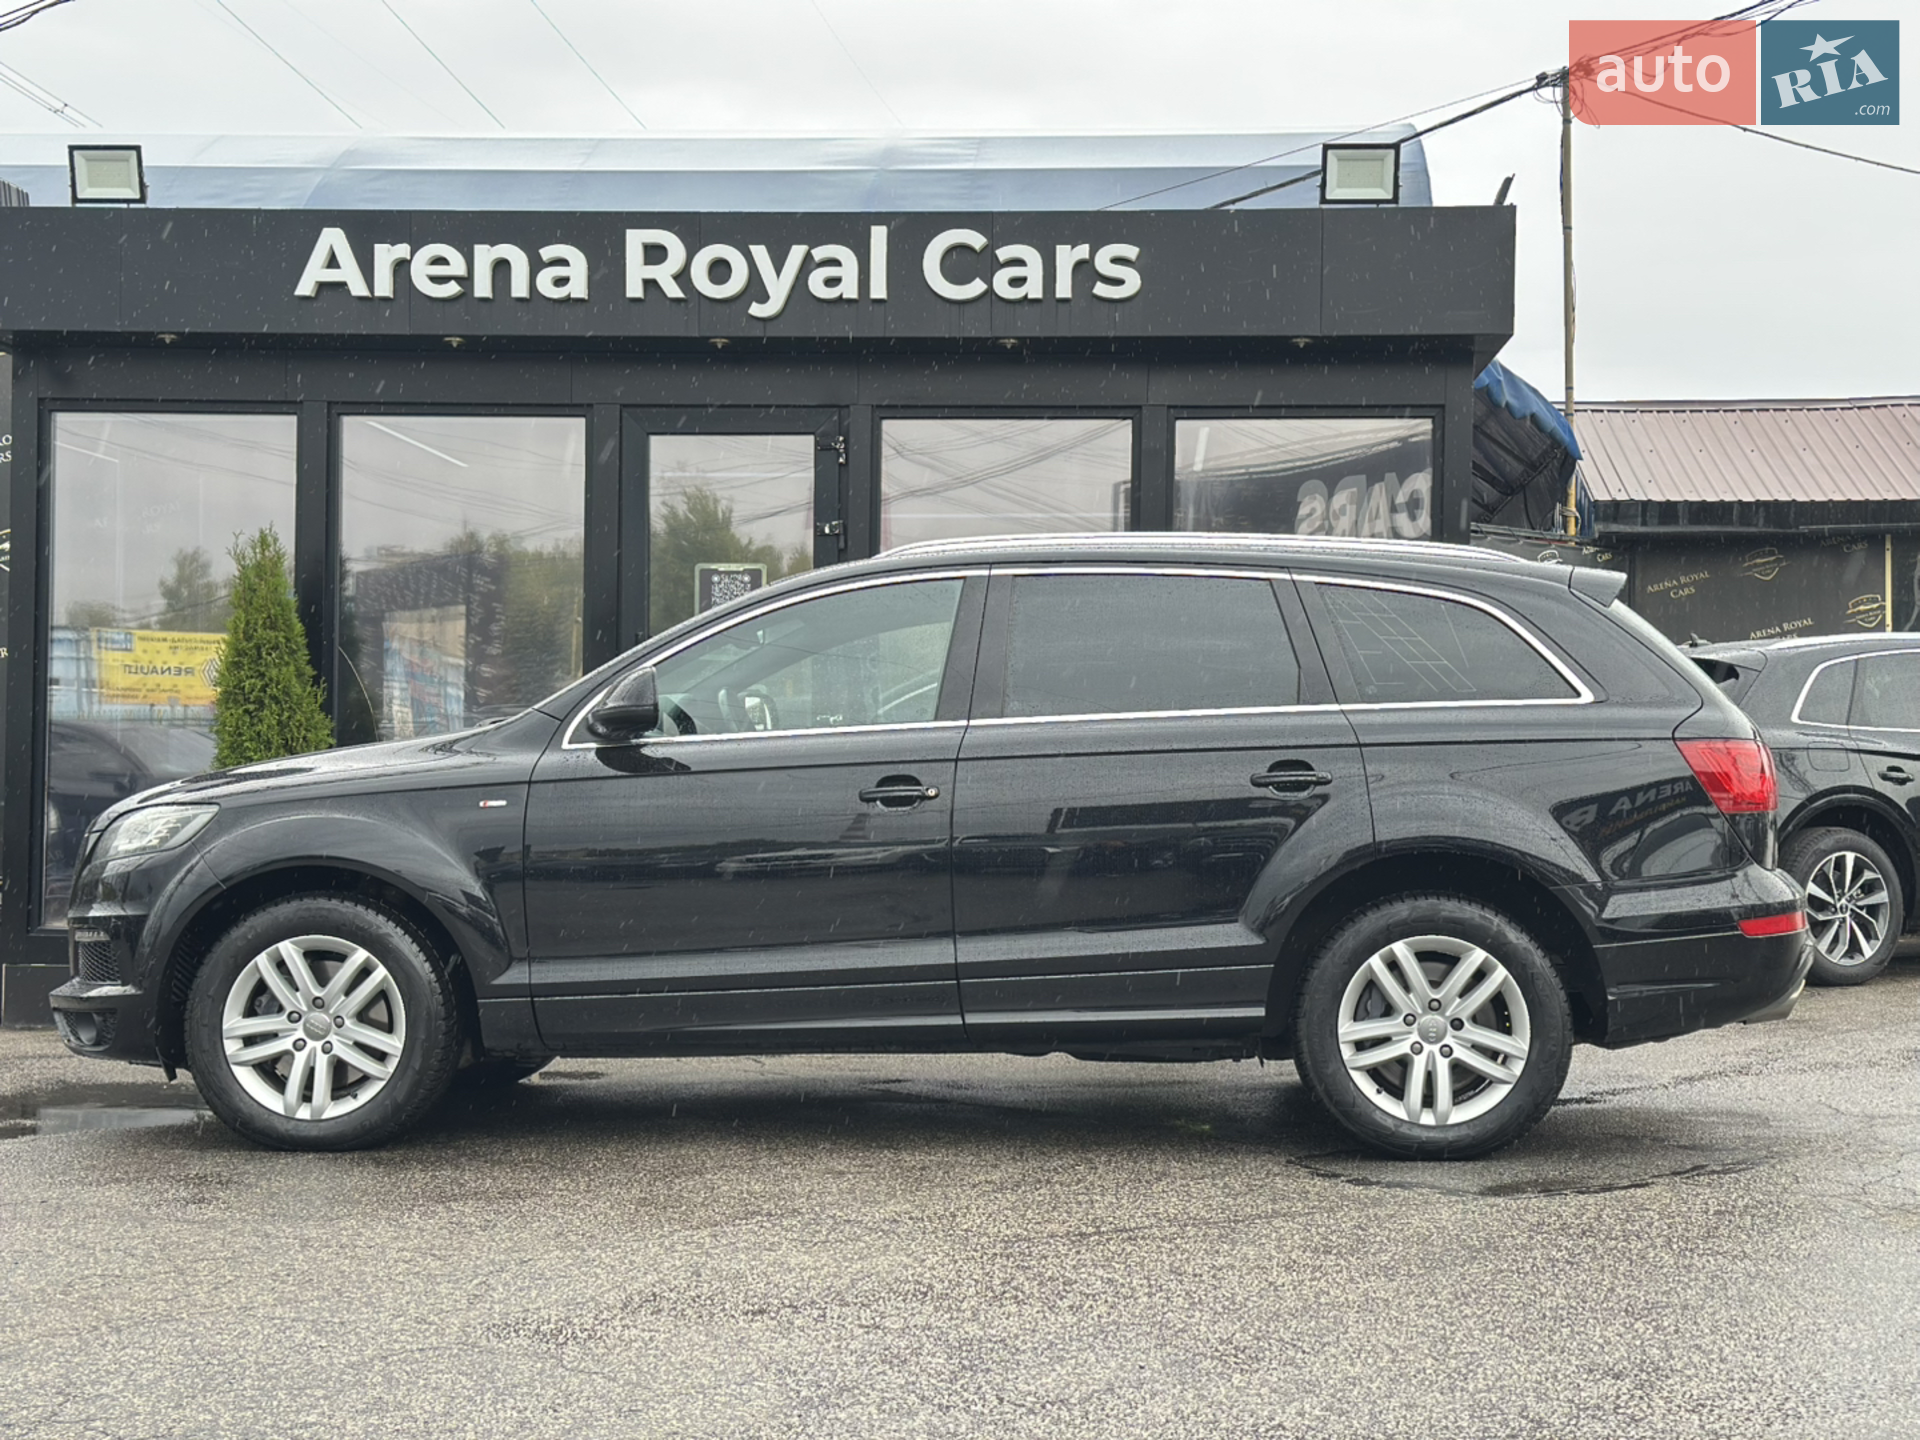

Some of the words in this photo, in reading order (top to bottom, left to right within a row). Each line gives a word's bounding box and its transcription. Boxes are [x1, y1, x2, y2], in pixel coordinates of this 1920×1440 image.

[293, 227, 589, 300] Arena
[625, 225, 888, 320] Royal
[922, 228, 1142, 301] Cars
[1646, 578, 1679, 595] ARENA
[1679, 570, 1712, 585] ROYAL
[1670, 585, 1696, 600] CARS
[1749, 626, 1782, 640] ARENA
[1782, 617, 1815, 632] ROYAL
